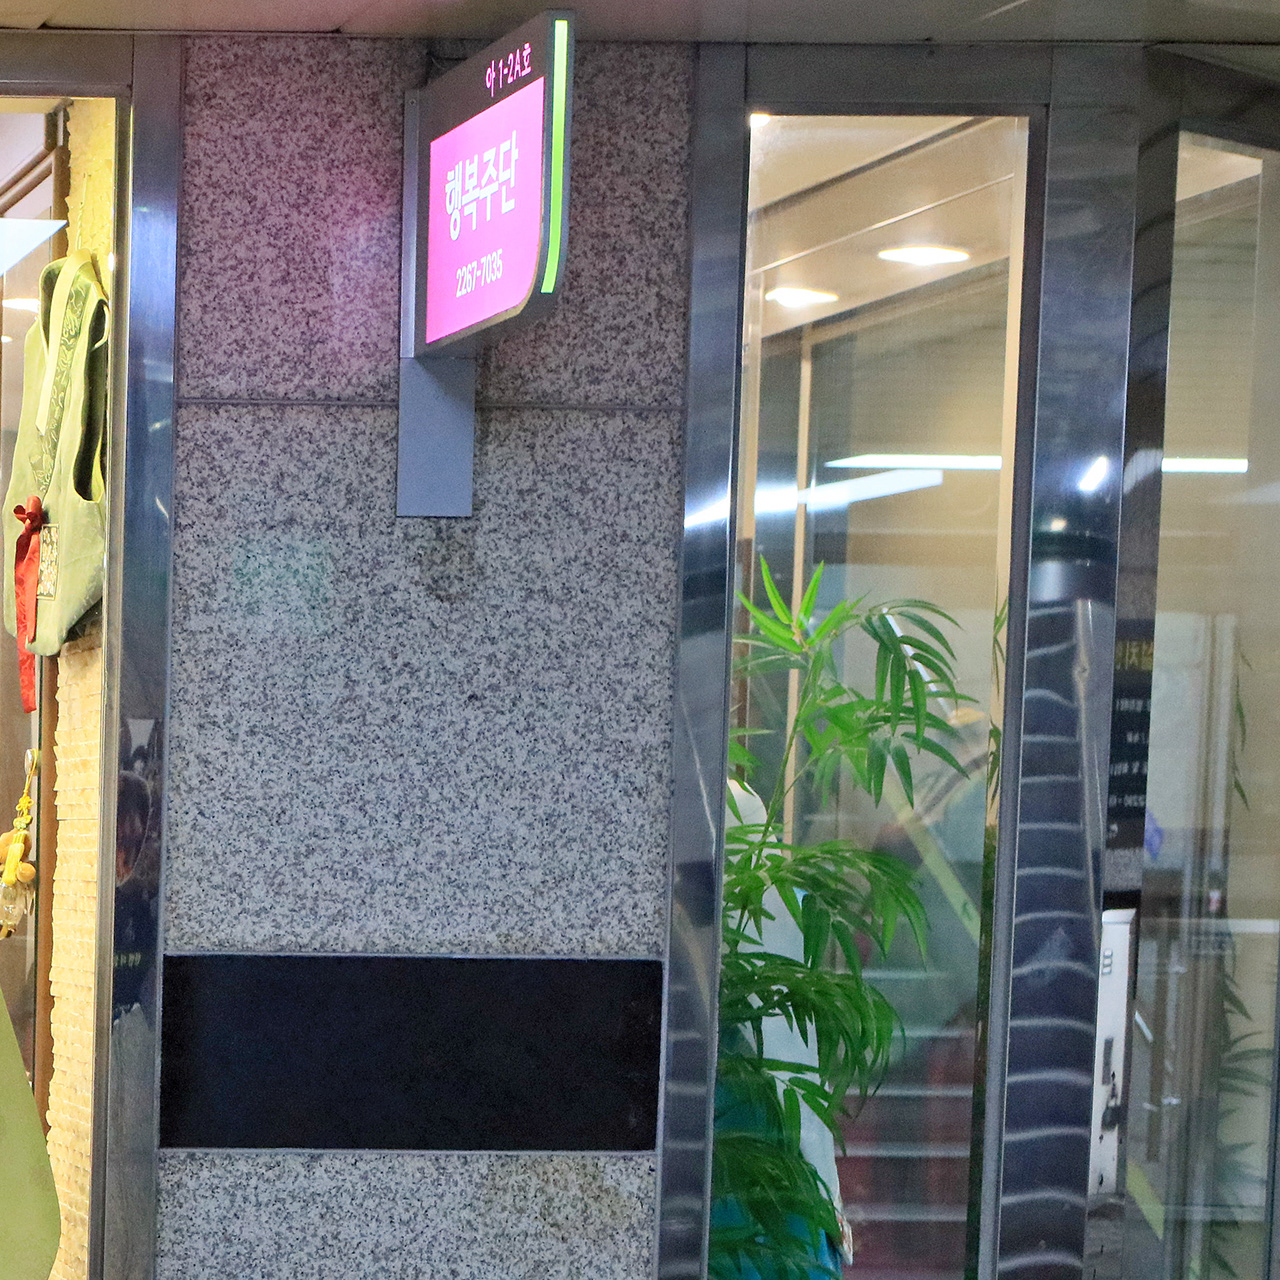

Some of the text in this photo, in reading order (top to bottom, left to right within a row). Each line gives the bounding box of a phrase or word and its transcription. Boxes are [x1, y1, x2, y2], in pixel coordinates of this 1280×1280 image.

[485, 42, 532, 98] 아 1-2A호
[445, 130, 519, 241] 행복주단
[455, 248, 503, 298] 2267-7035
